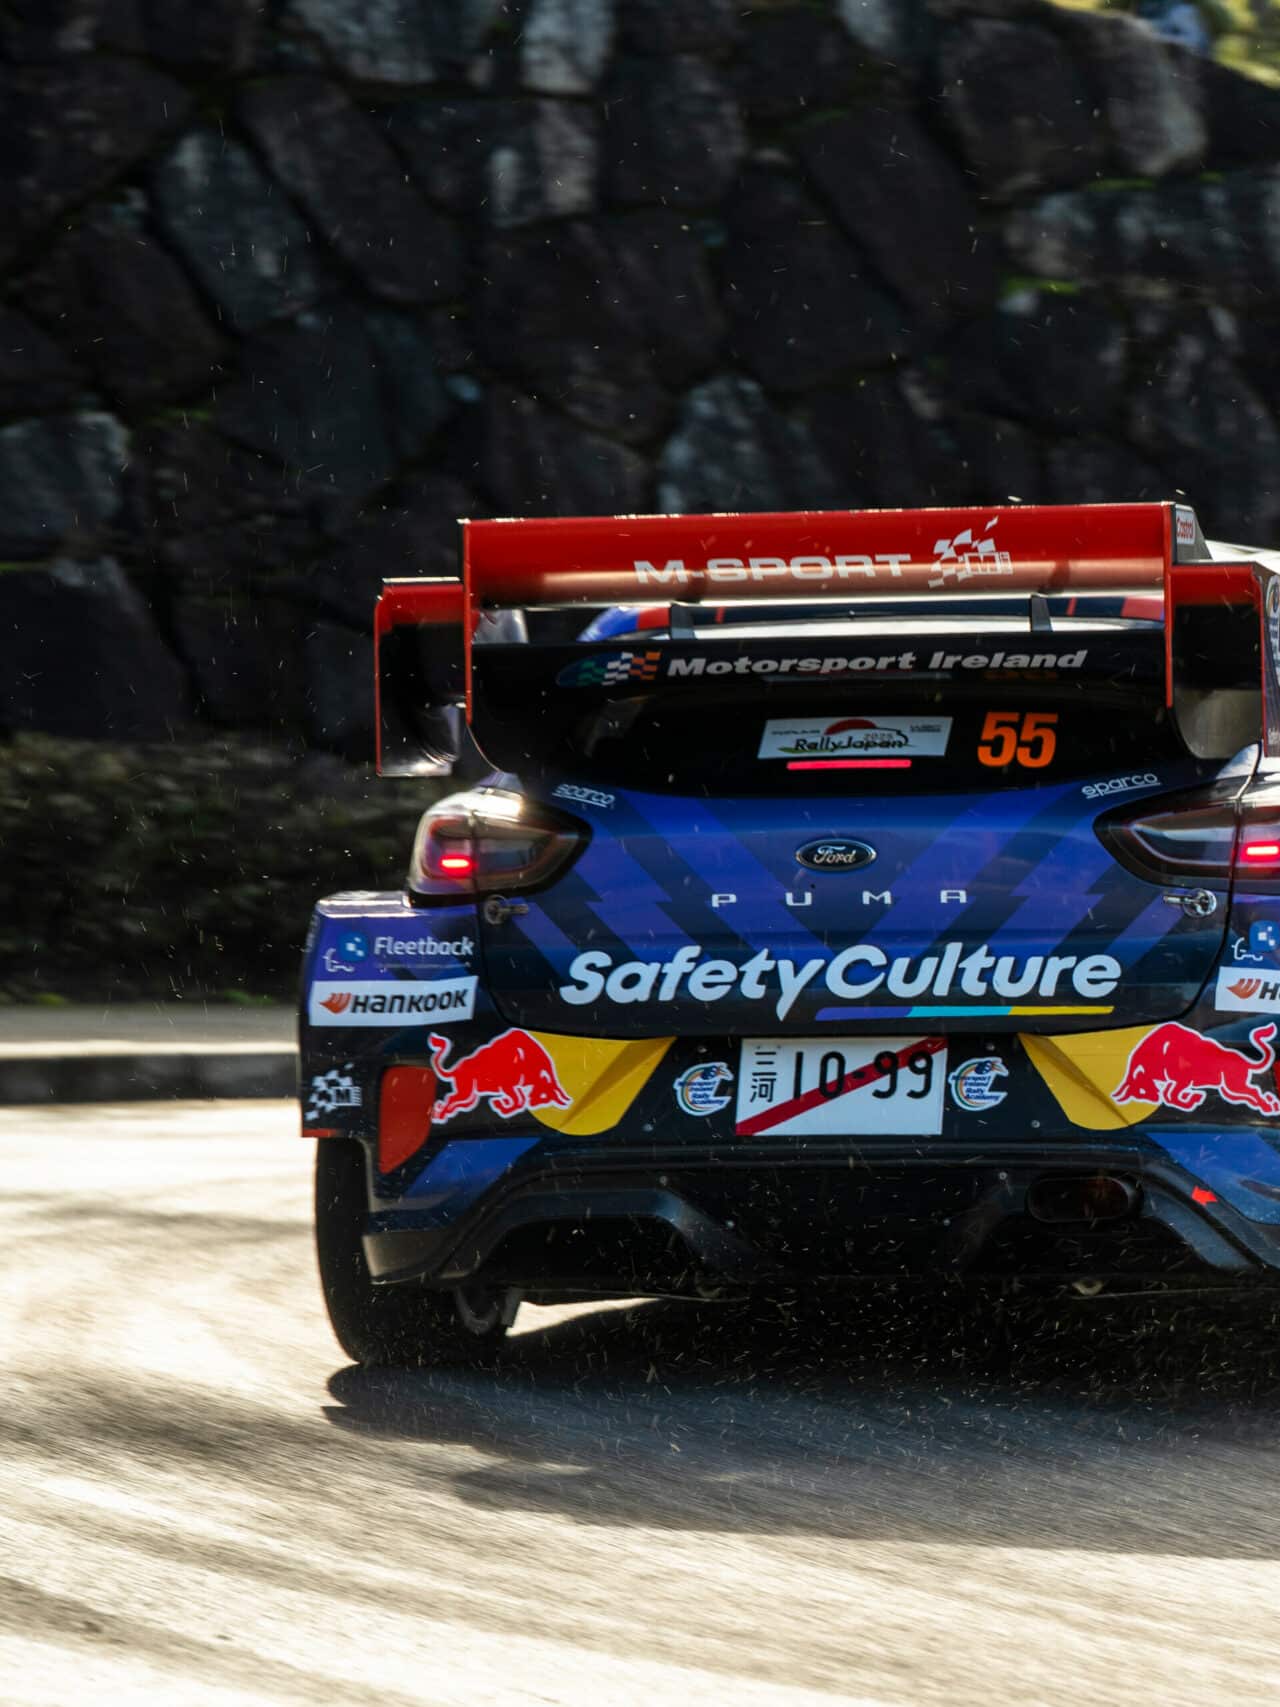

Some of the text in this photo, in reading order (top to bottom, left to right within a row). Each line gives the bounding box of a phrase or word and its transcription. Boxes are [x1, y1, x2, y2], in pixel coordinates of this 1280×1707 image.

[634, 553, 911, 584] M-SPORT
[667, 650, 1088, 676] Motorsport Ireland
[977, 711, 1059, 768] 55
[1081, 773, 1162, 799] sparco
[813, 845, 857, 863] Ford
[374, 936, 475, 955] Fleetback
[560, 942, 1123, 1022] SafetyCulture
[750, 1050, 777, 1103] 三河
[793, 1050, 934, 1100] 10-99
